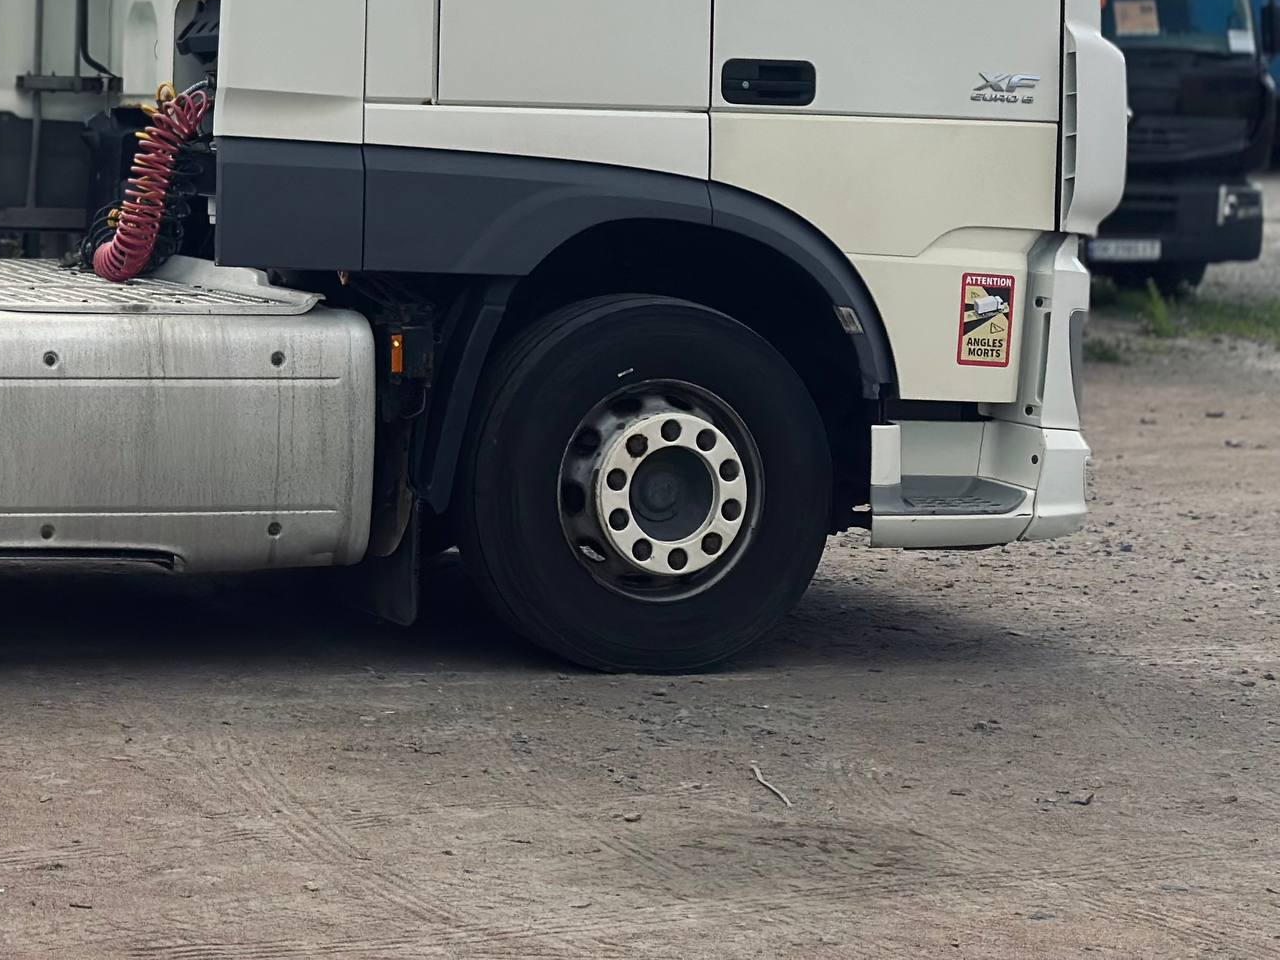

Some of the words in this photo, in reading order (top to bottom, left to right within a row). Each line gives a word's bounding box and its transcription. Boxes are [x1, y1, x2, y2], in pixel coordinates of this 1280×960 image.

[973, 72, 1040, 92] XF
[966, 276, 1012, 287] ATTENTION
[967, 337, 1004, 348] ANGLES
[968, 348, 1001, 358] MORTS
